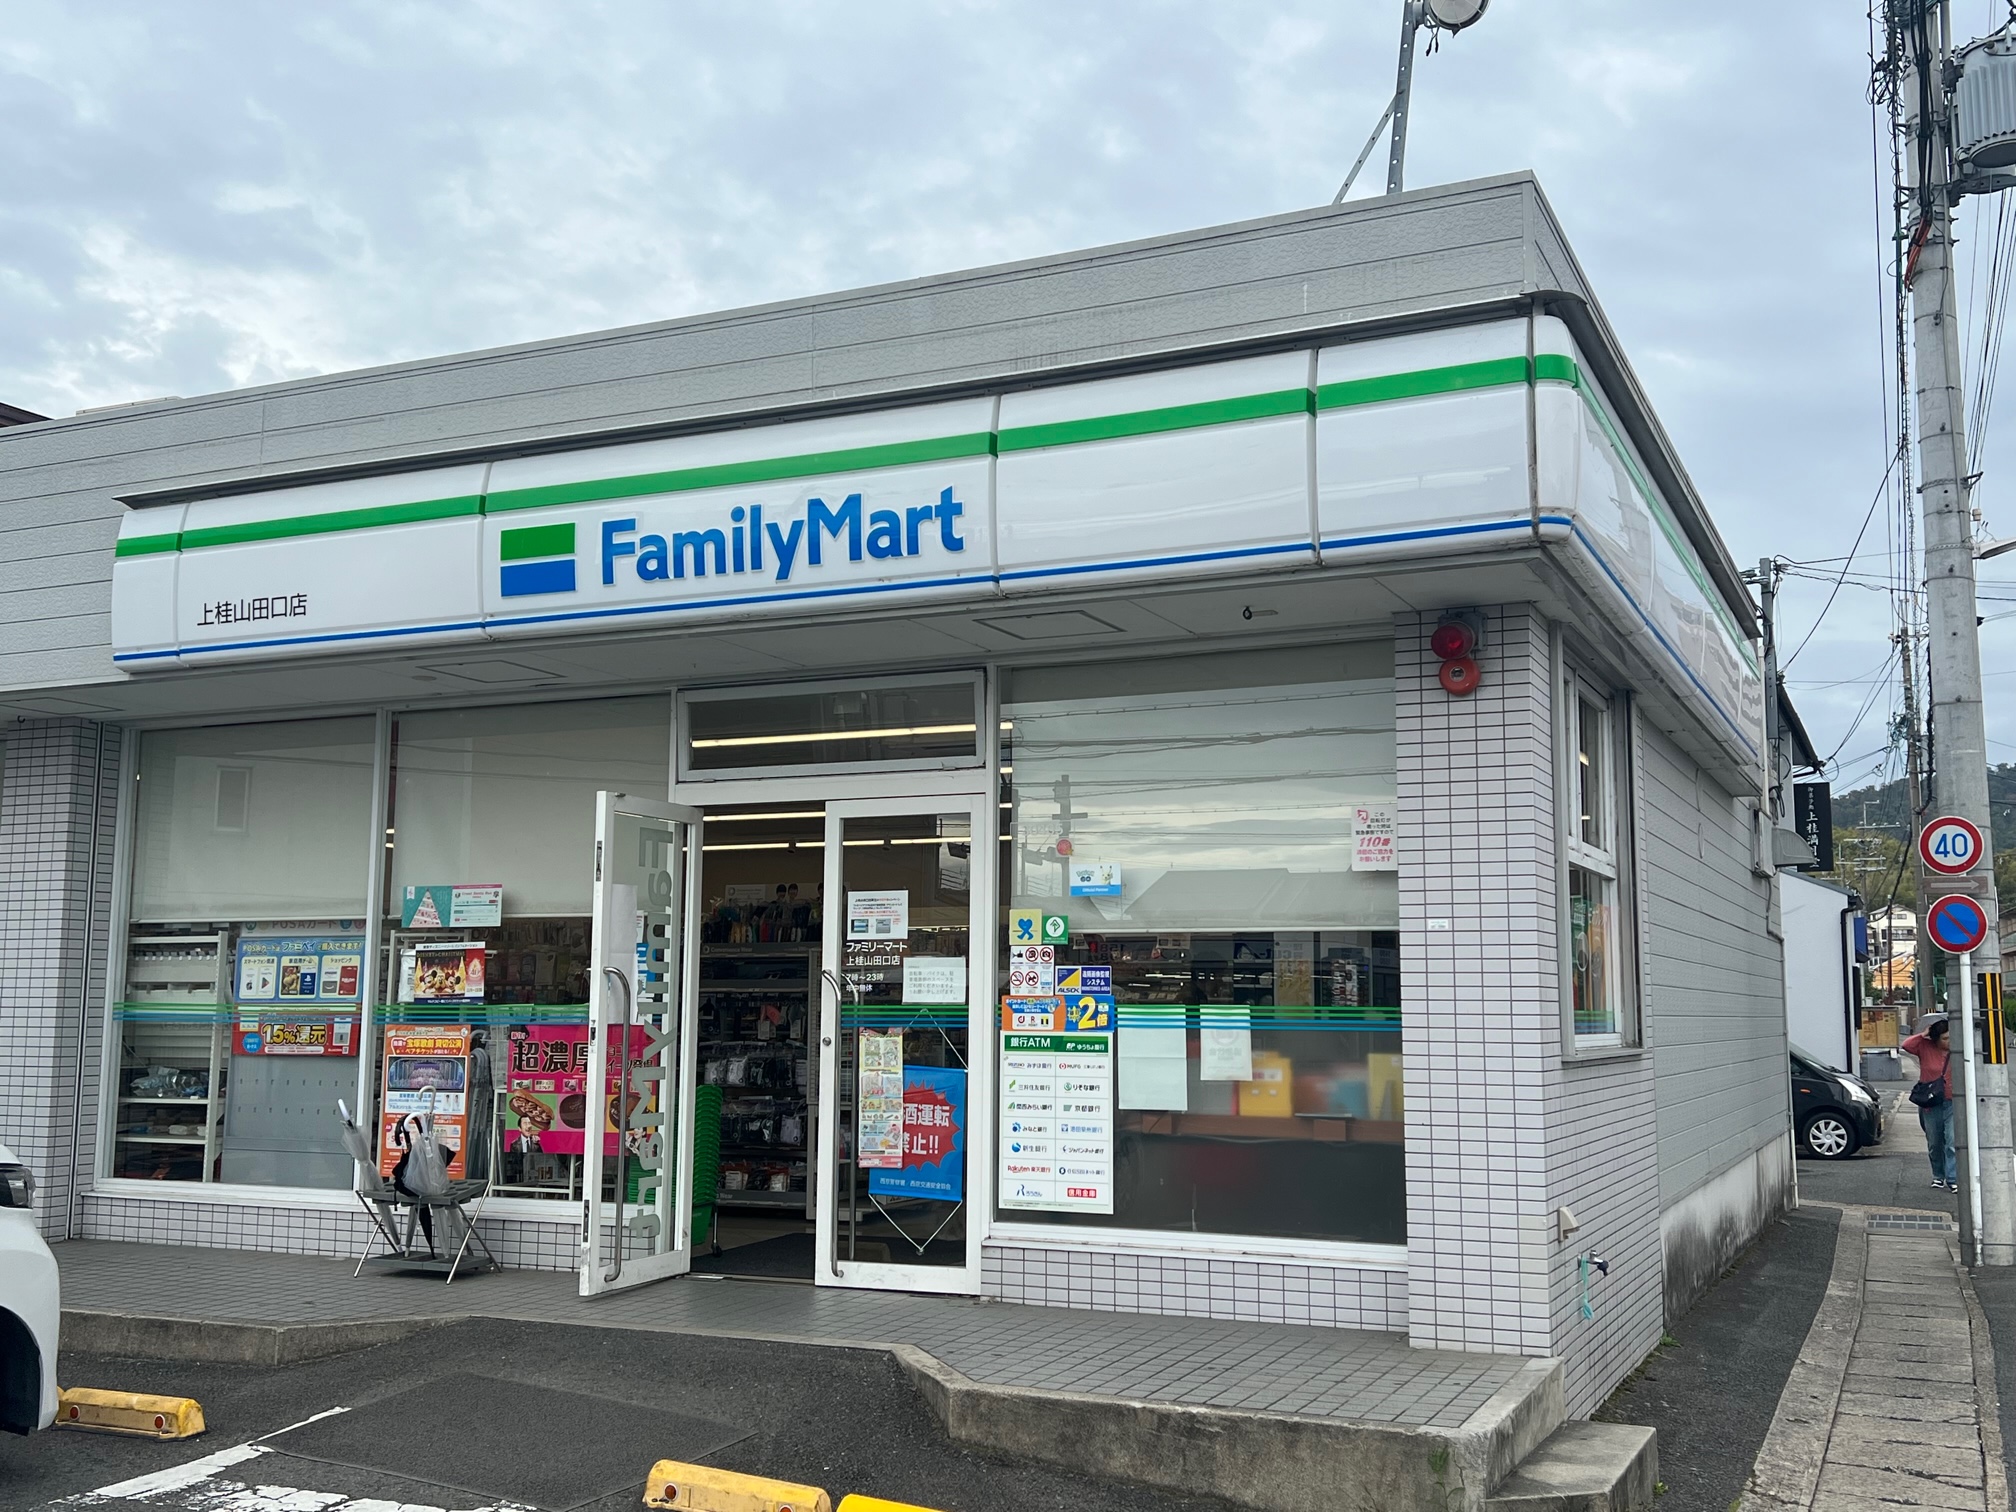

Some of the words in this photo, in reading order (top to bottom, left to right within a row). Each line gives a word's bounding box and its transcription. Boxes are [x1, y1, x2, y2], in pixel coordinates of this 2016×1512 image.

[602, 485, 965, 585] FamilyMart
[197, 593, 307, 626] 上桂山田口店
[1360, 837, 1391, 847] 110番
[1935, 833, 1968, 858] 40
[282, 941, 317, 951] ファミペイ
[846, 941, 907, 952] ファミリーマート
[846, 956, 900, 966] 上桂山田口店
[1010, 1037, 1051, 1047] 銀行ATM
[512, 1041, 588, 1073] 超濃厚
[902, 1103, 949, 1127] 酒運転
[1008, 1165, 1030, 1173] Rakuten
[1067, 1189, 1096, 1198] 信用金庫
